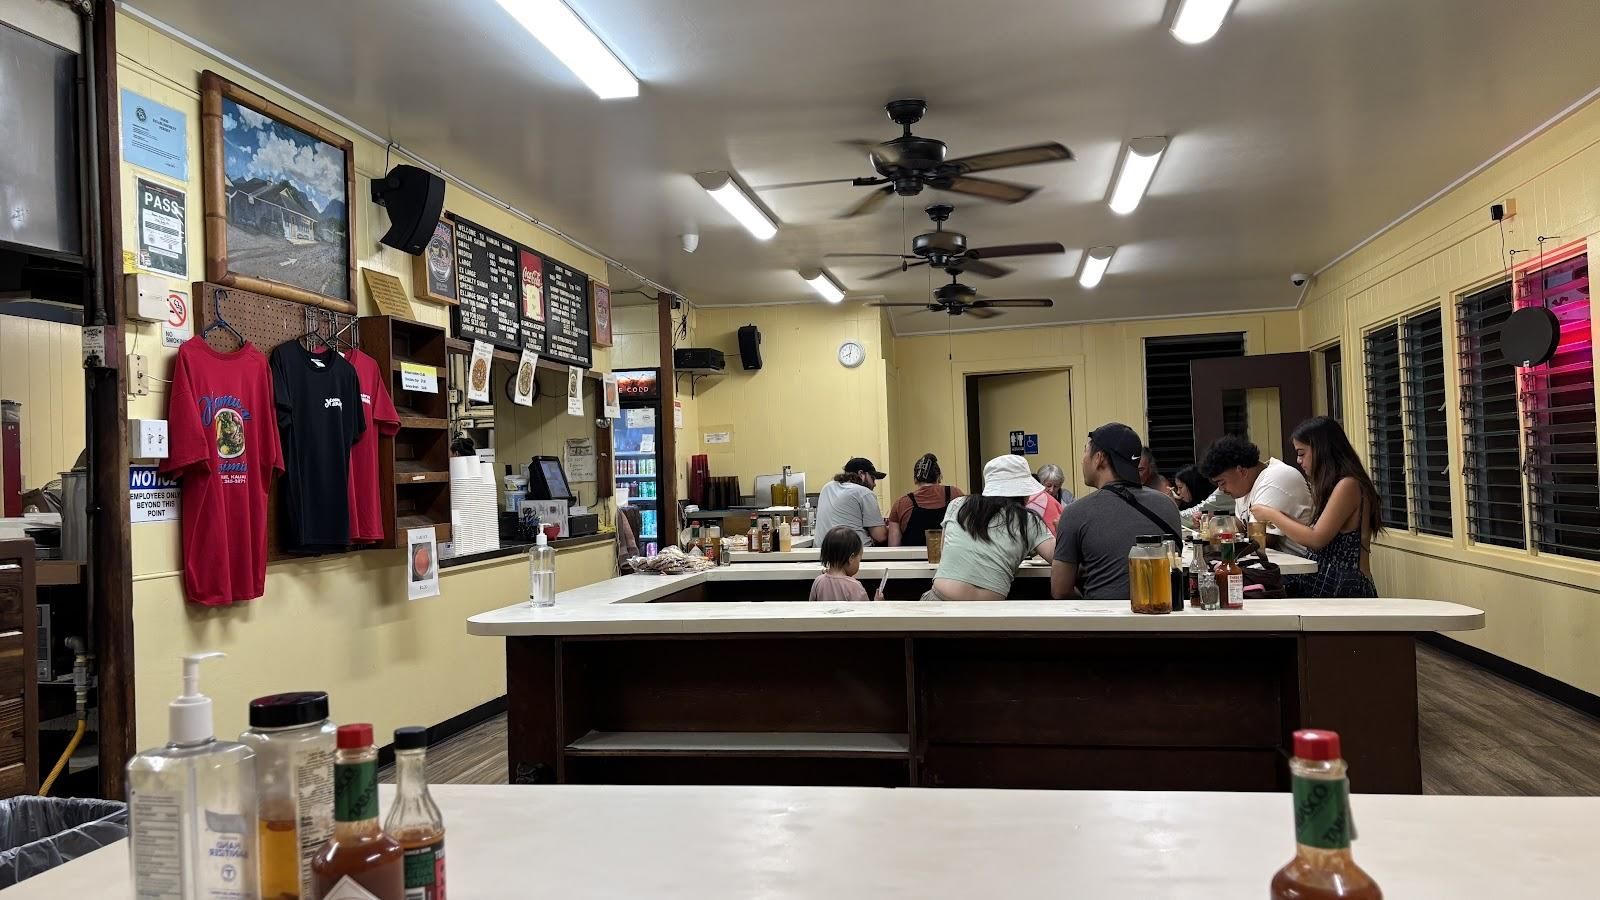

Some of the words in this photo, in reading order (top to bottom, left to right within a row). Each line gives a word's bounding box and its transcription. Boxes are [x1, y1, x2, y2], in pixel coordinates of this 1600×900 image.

[144, 191, 182, 216] PASS
[627, 386, 649, 394] COLD
[129, 491, 164, 501] EMPLOYEES
[165, 490, 181, 499] ONLY
[136, 500, 161, 509] BEYOND
[161, 500, 176, 508] THIS
[147, 509, 166, 517] POINT
